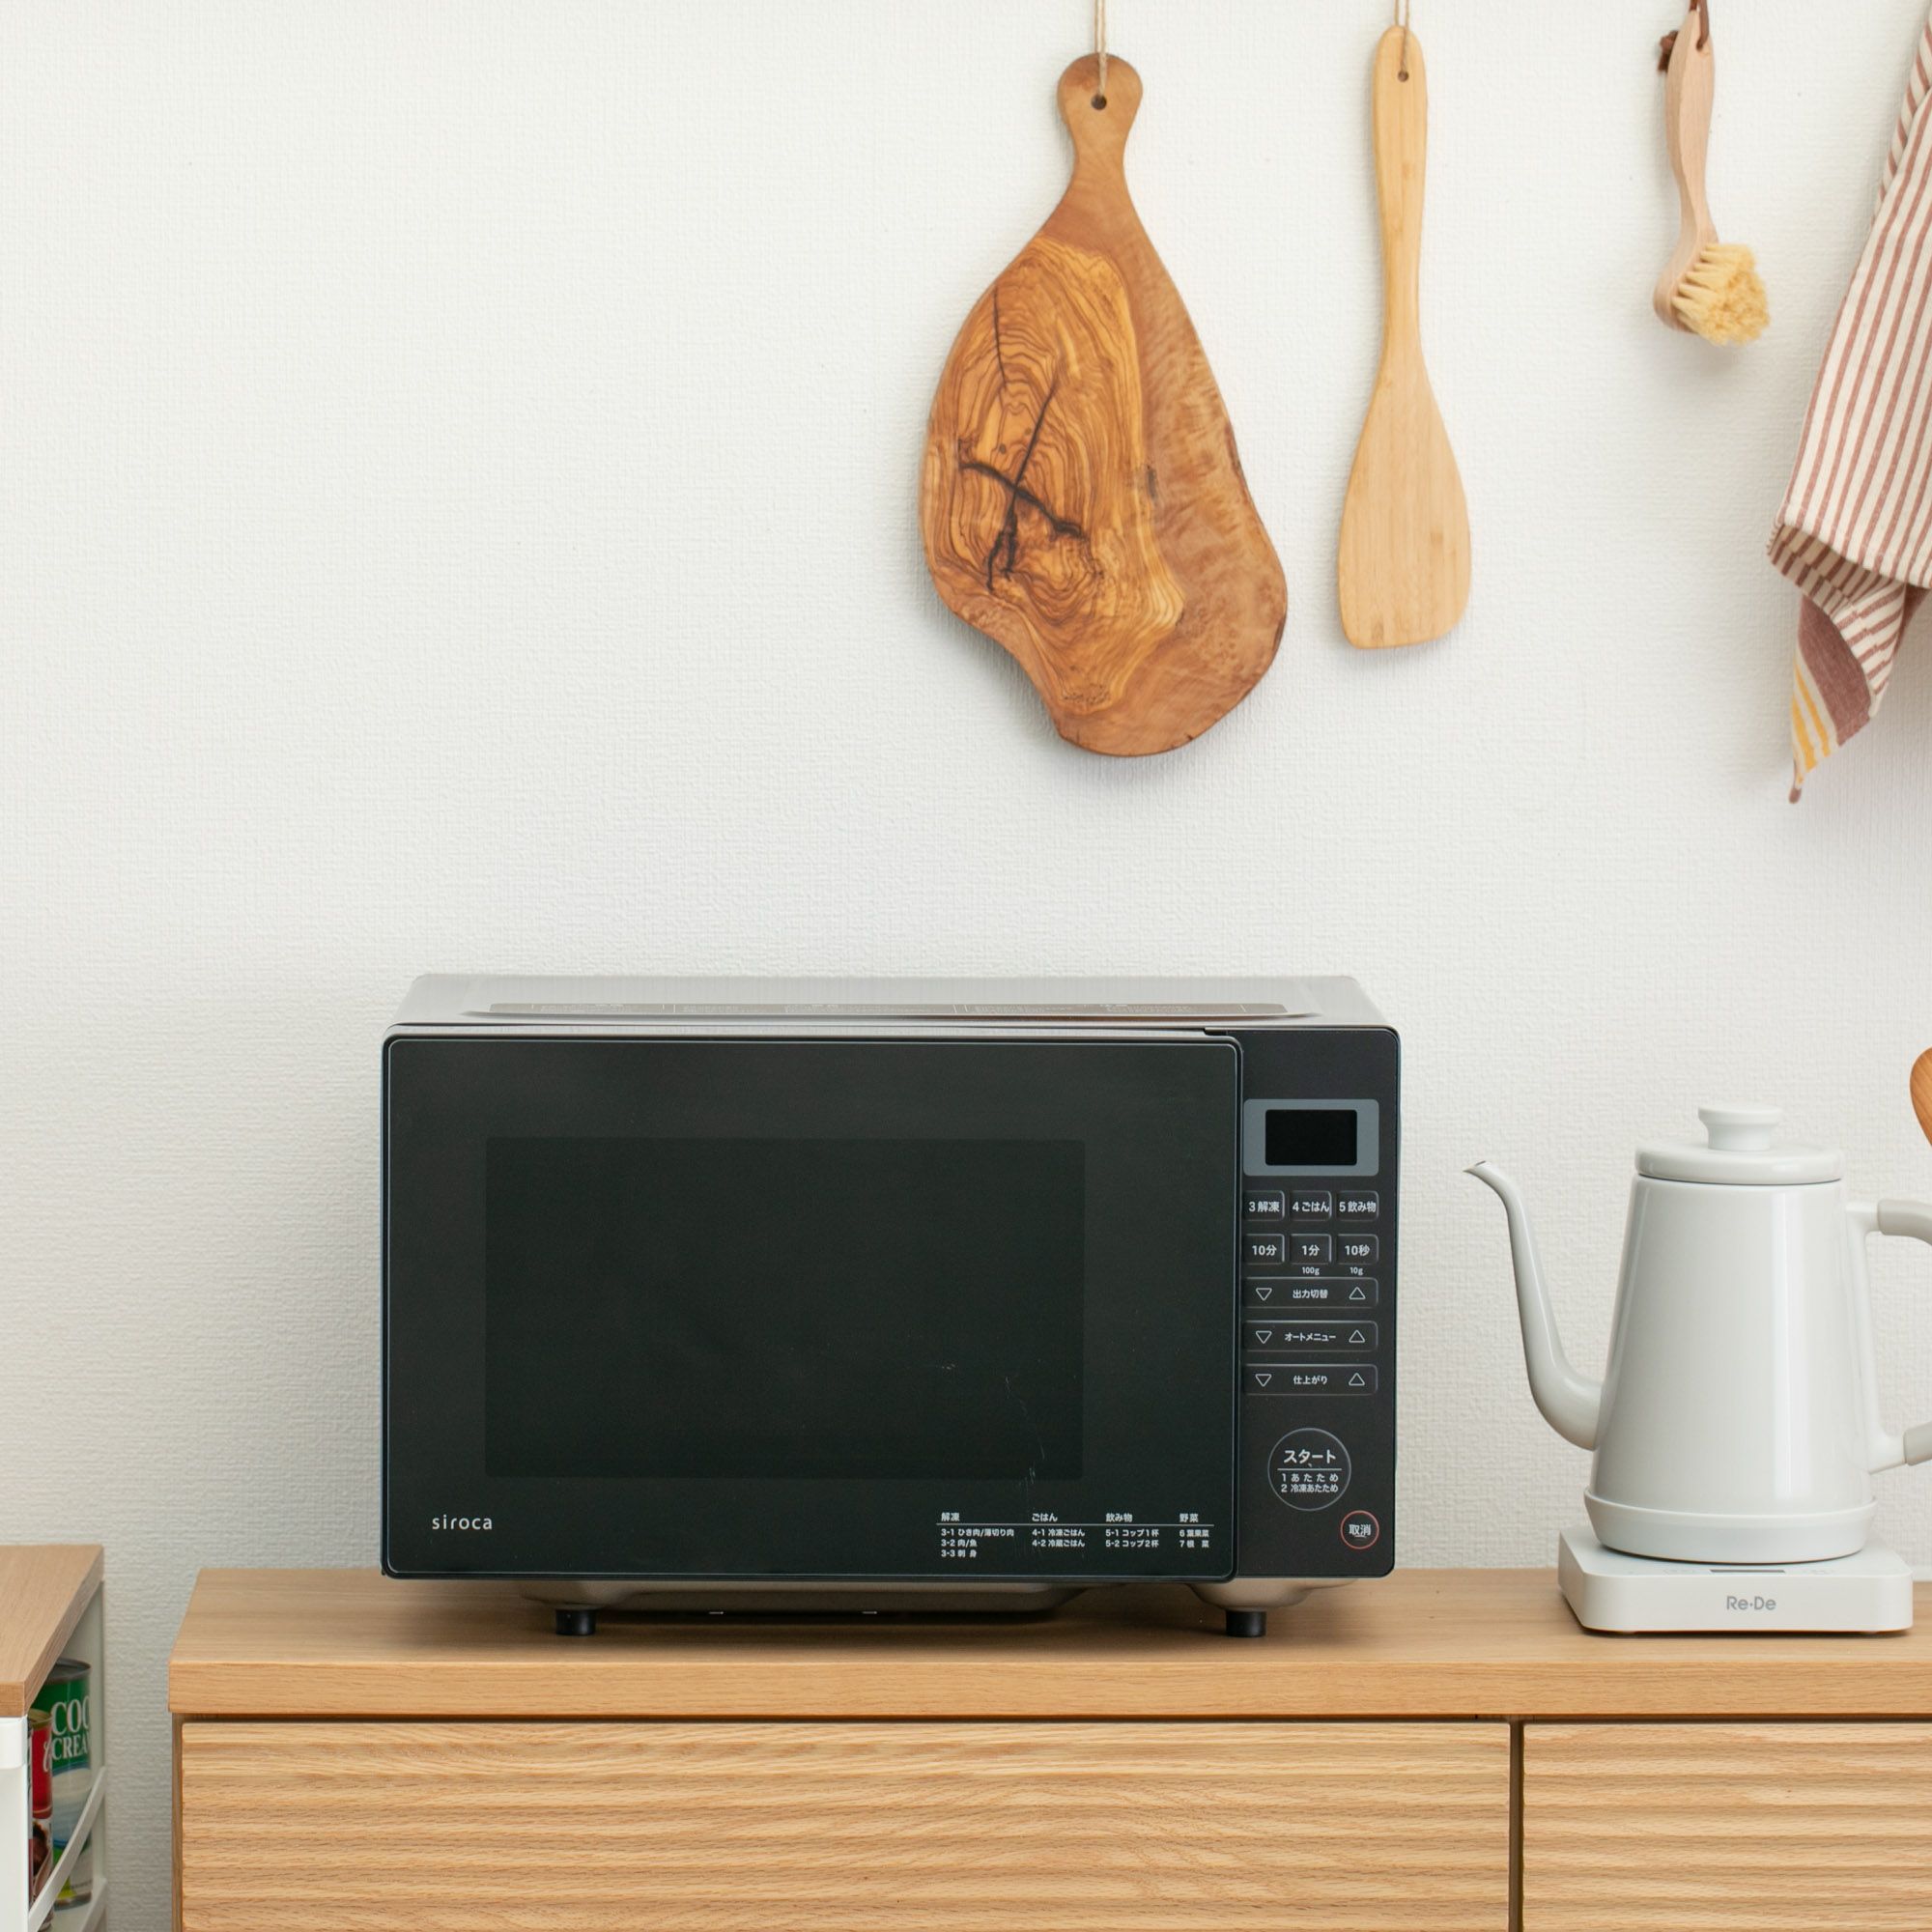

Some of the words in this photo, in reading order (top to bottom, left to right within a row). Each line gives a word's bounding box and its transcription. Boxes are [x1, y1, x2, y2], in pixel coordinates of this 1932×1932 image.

[1248, 1202, 1256, 1212] 3
[1257, 1201, 1280, 1212] 解凍
[1292, 1202, 1299, 1212] 4
[1301, 1202, 1330, 1212] ごはん
[1339, 1202, 1346, 1212] 5
[1348, 1201, 1377, 1213] 飲み物
[1252, 1244, 1277, 1257] 10分
[1301, 1244, 1321, 1257] 1分
[1345, 1244, 1371, 1257] 10秒
[1301, 1266, 1321, 1275] 100g
[1350, 1266, 1364, 1276] 10g
[1293, 1289, 1328, 1299] 出力切替
[1285, 1332, 1336, 1342] オートメニュー
[1293, 1375, 1328, 1385] 仕上がり
[1283, 1449, 1336, 1463] スタート
[1281, 1484, 1288, 1492] 2
[1291, 1484, 1339, 1492] 冷凍あたため
[432, 1514, 493, 1530] siroca
[1032, 1513, 1058, 1522] ごはん
[1105, 1513, 1133, 1522] 飲み物
[1179, 1513, 1199, 1522] 野菜
[941, 1528, 955, 1537] 3-1
[1032, 1528, 1045, 1537] 4-1
[1349, 1523, 1371, 1536] 取消
[1105, 1539, 1121, 1548] 5-2
[51, 1731, 90, 1760] CREA
